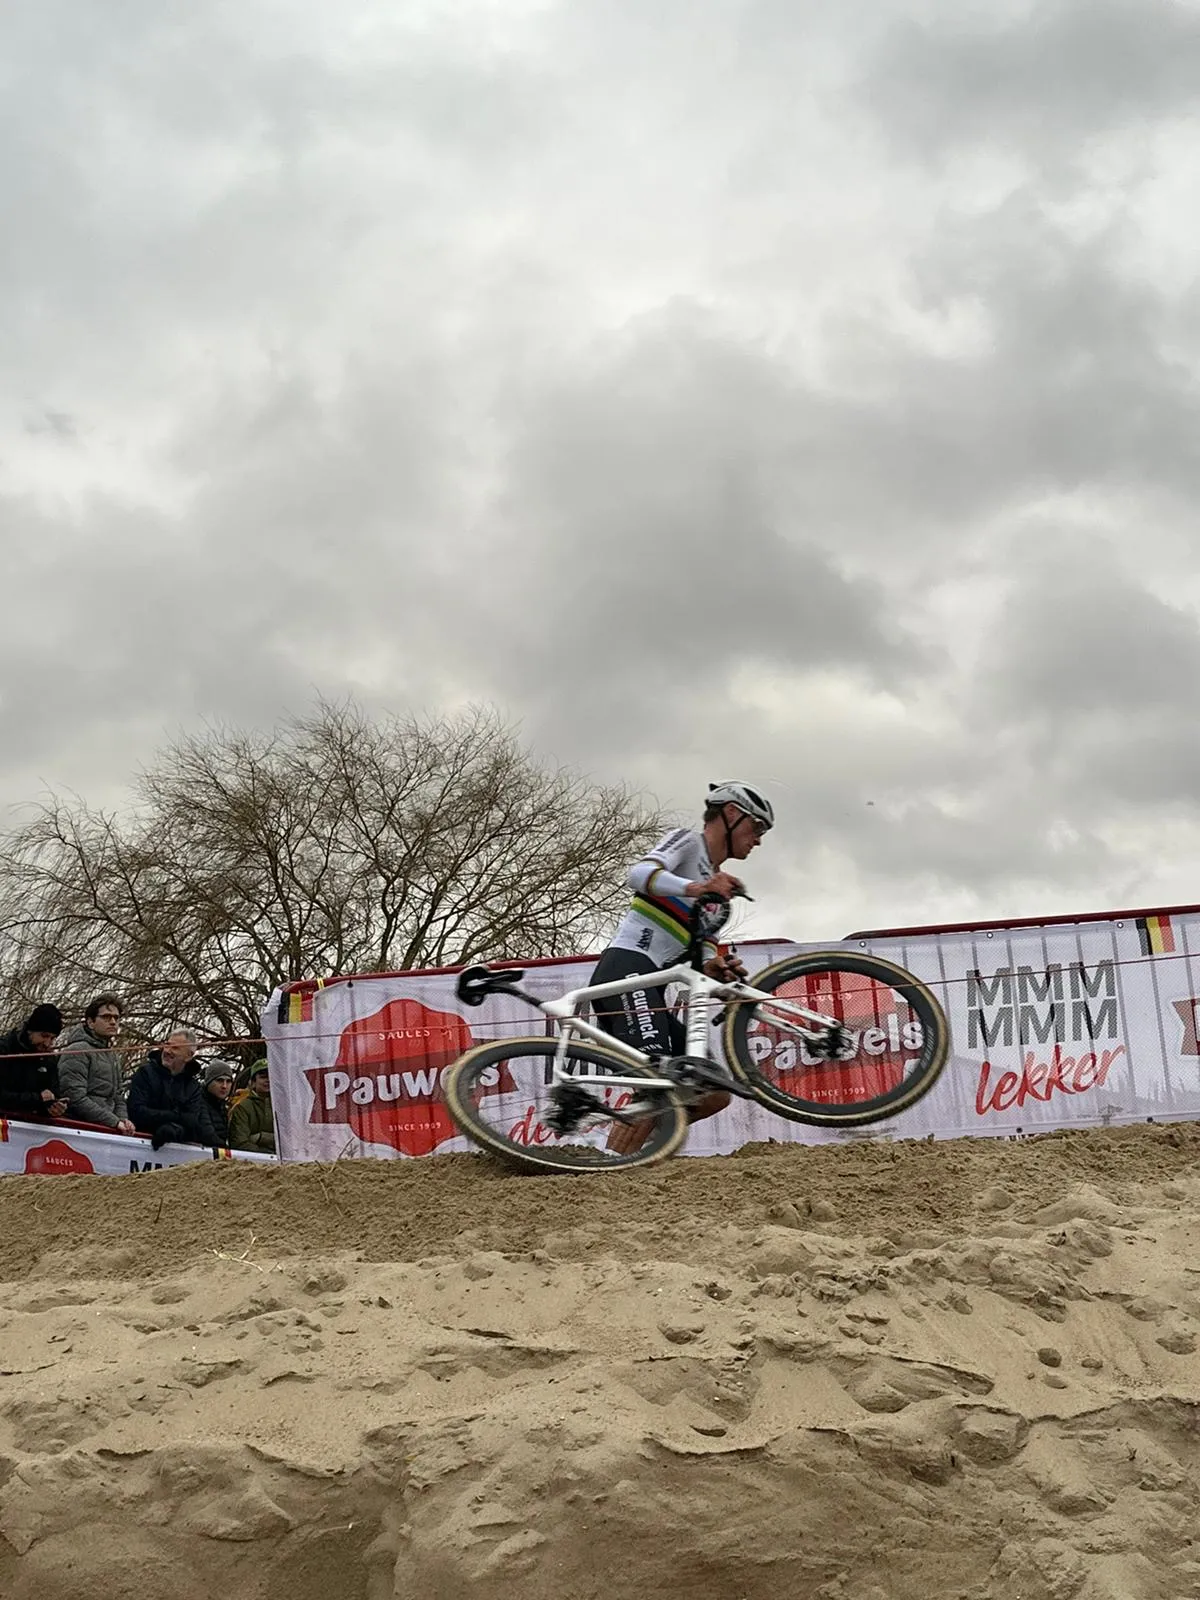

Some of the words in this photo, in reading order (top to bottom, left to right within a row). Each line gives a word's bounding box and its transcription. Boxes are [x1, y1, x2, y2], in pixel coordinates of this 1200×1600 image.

[966, 959, 1116, 1007] MMM
[747, 1012, 924, 1070] Pauels
[967, 999, 1118, 1049] MMM
[323, 1061, 500, 1110] Pauws
[812, 1089, 840, 1098] SINCE
[976, 1043, 1127, 1115] lekker
[389, 1123, 415, 1132] SINCE
[45, 1156, 73, 1167] SAUCES
